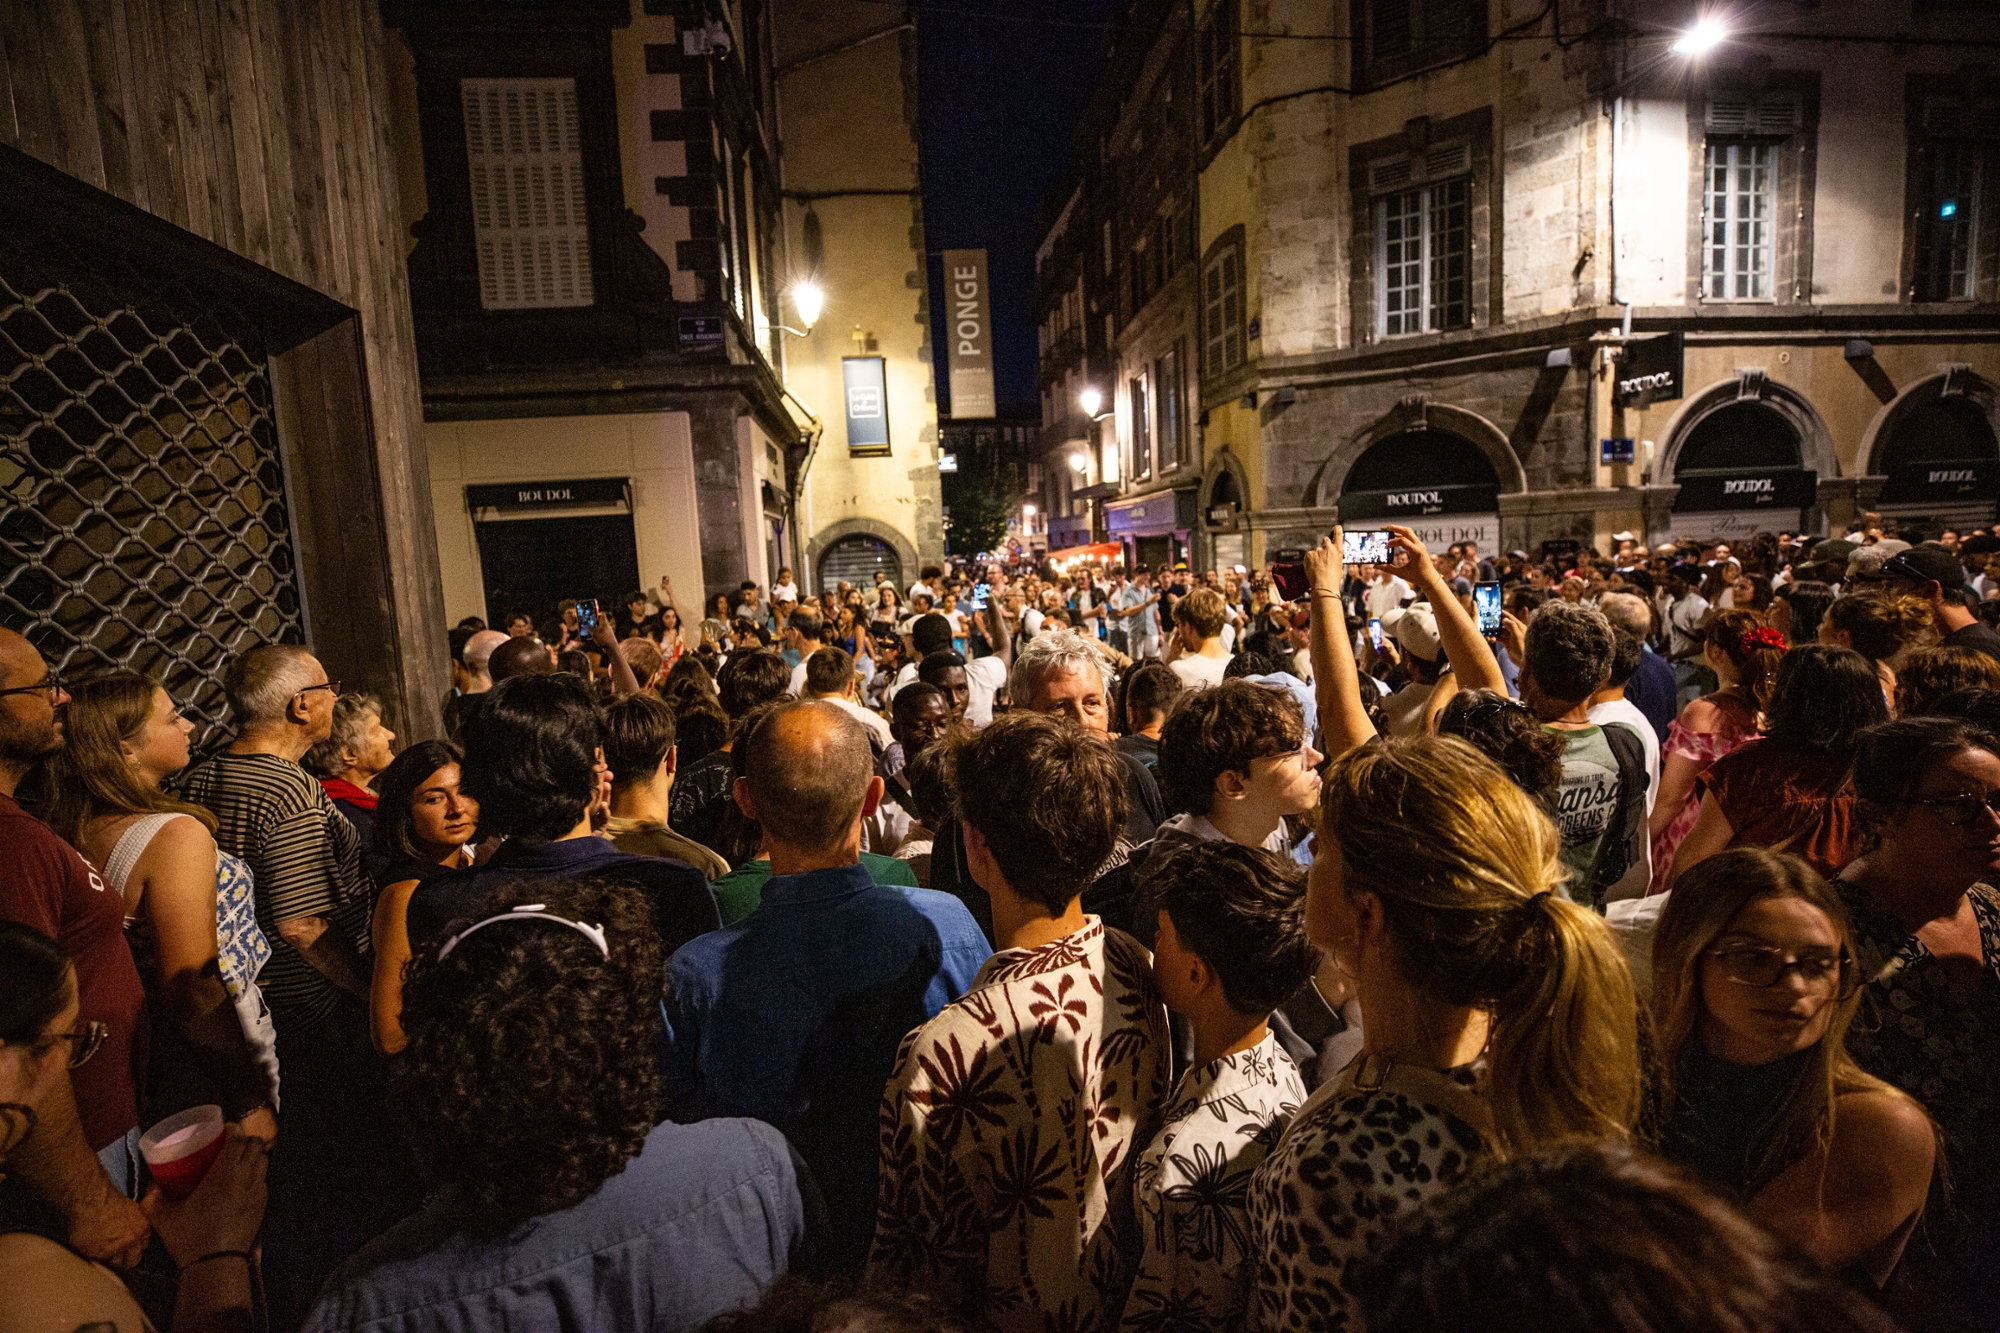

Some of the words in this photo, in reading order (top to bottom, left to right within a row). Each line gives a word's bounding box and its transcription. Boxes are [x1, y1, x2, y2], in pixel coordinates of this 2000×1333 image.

[954, 265, 981, 356] PONGE
[1620, 371, 1674, 394] BOUDOL
[1724, 479, 1775, 494] BOUDOL
[518, 488, 574, 502] BOUDOL
[1387, 491, 1443, 506] BOUDOL
